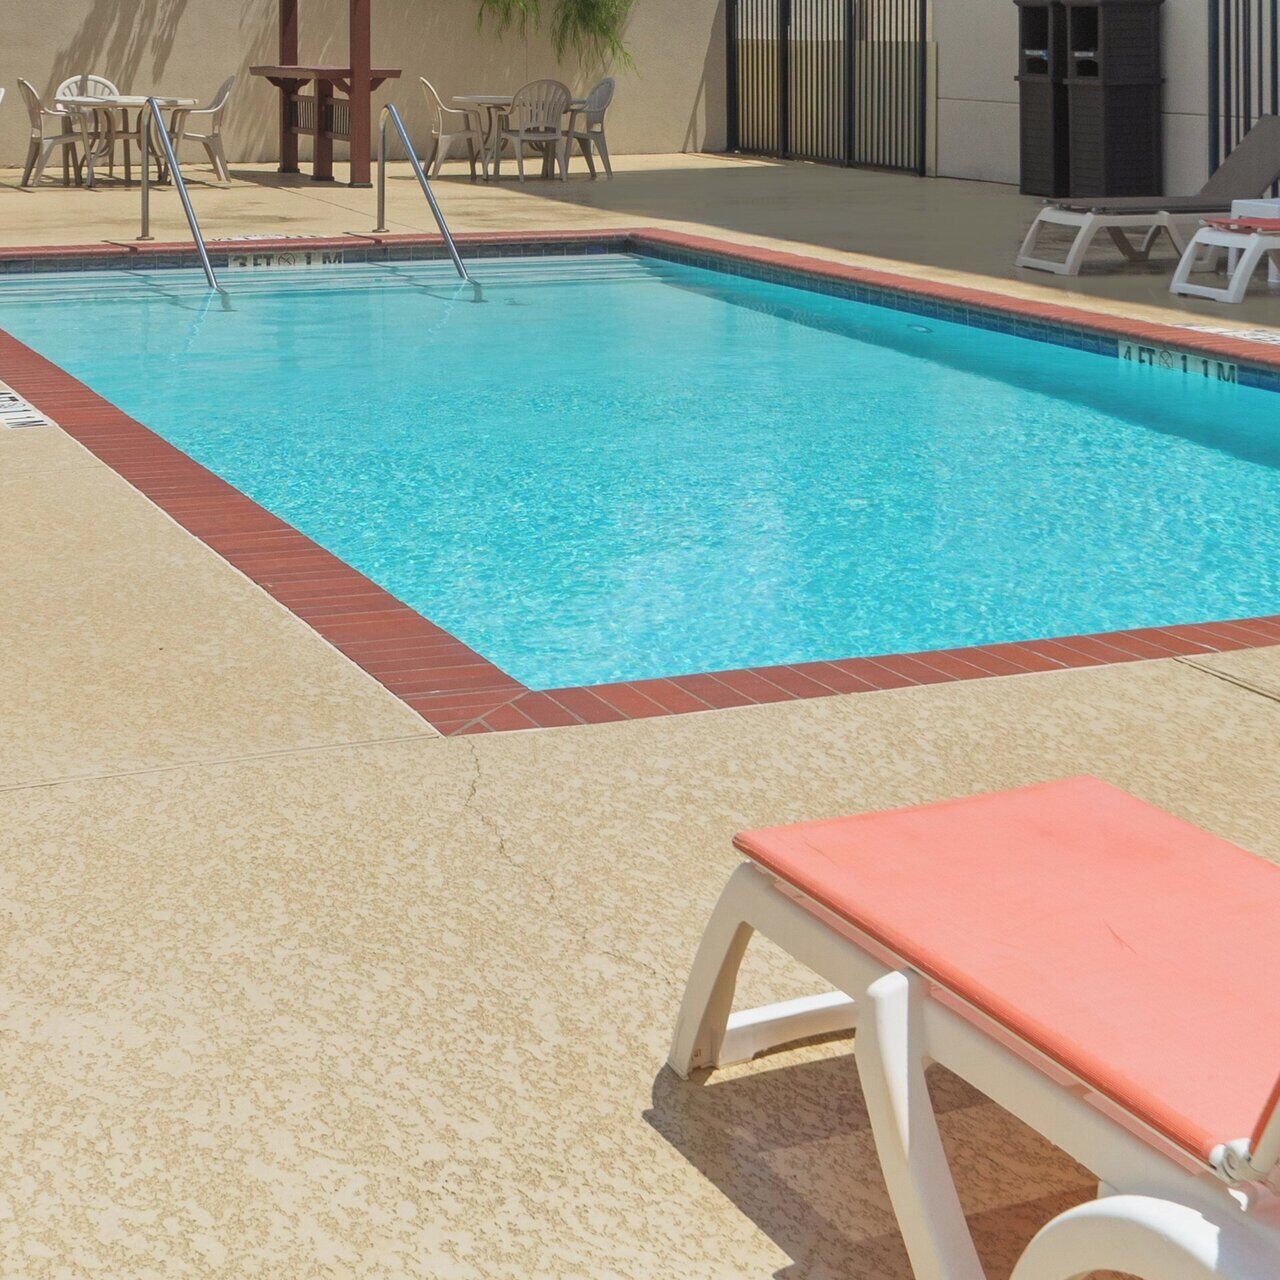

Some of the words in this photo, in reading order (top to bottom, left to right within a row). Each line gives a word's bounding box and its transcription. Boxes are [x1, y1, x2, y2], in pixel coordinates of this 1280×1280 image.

[253, 253, 274, 267] FT
[1138, 346, 1155, 366] FT
[1217, 362, 1236, 384] M
